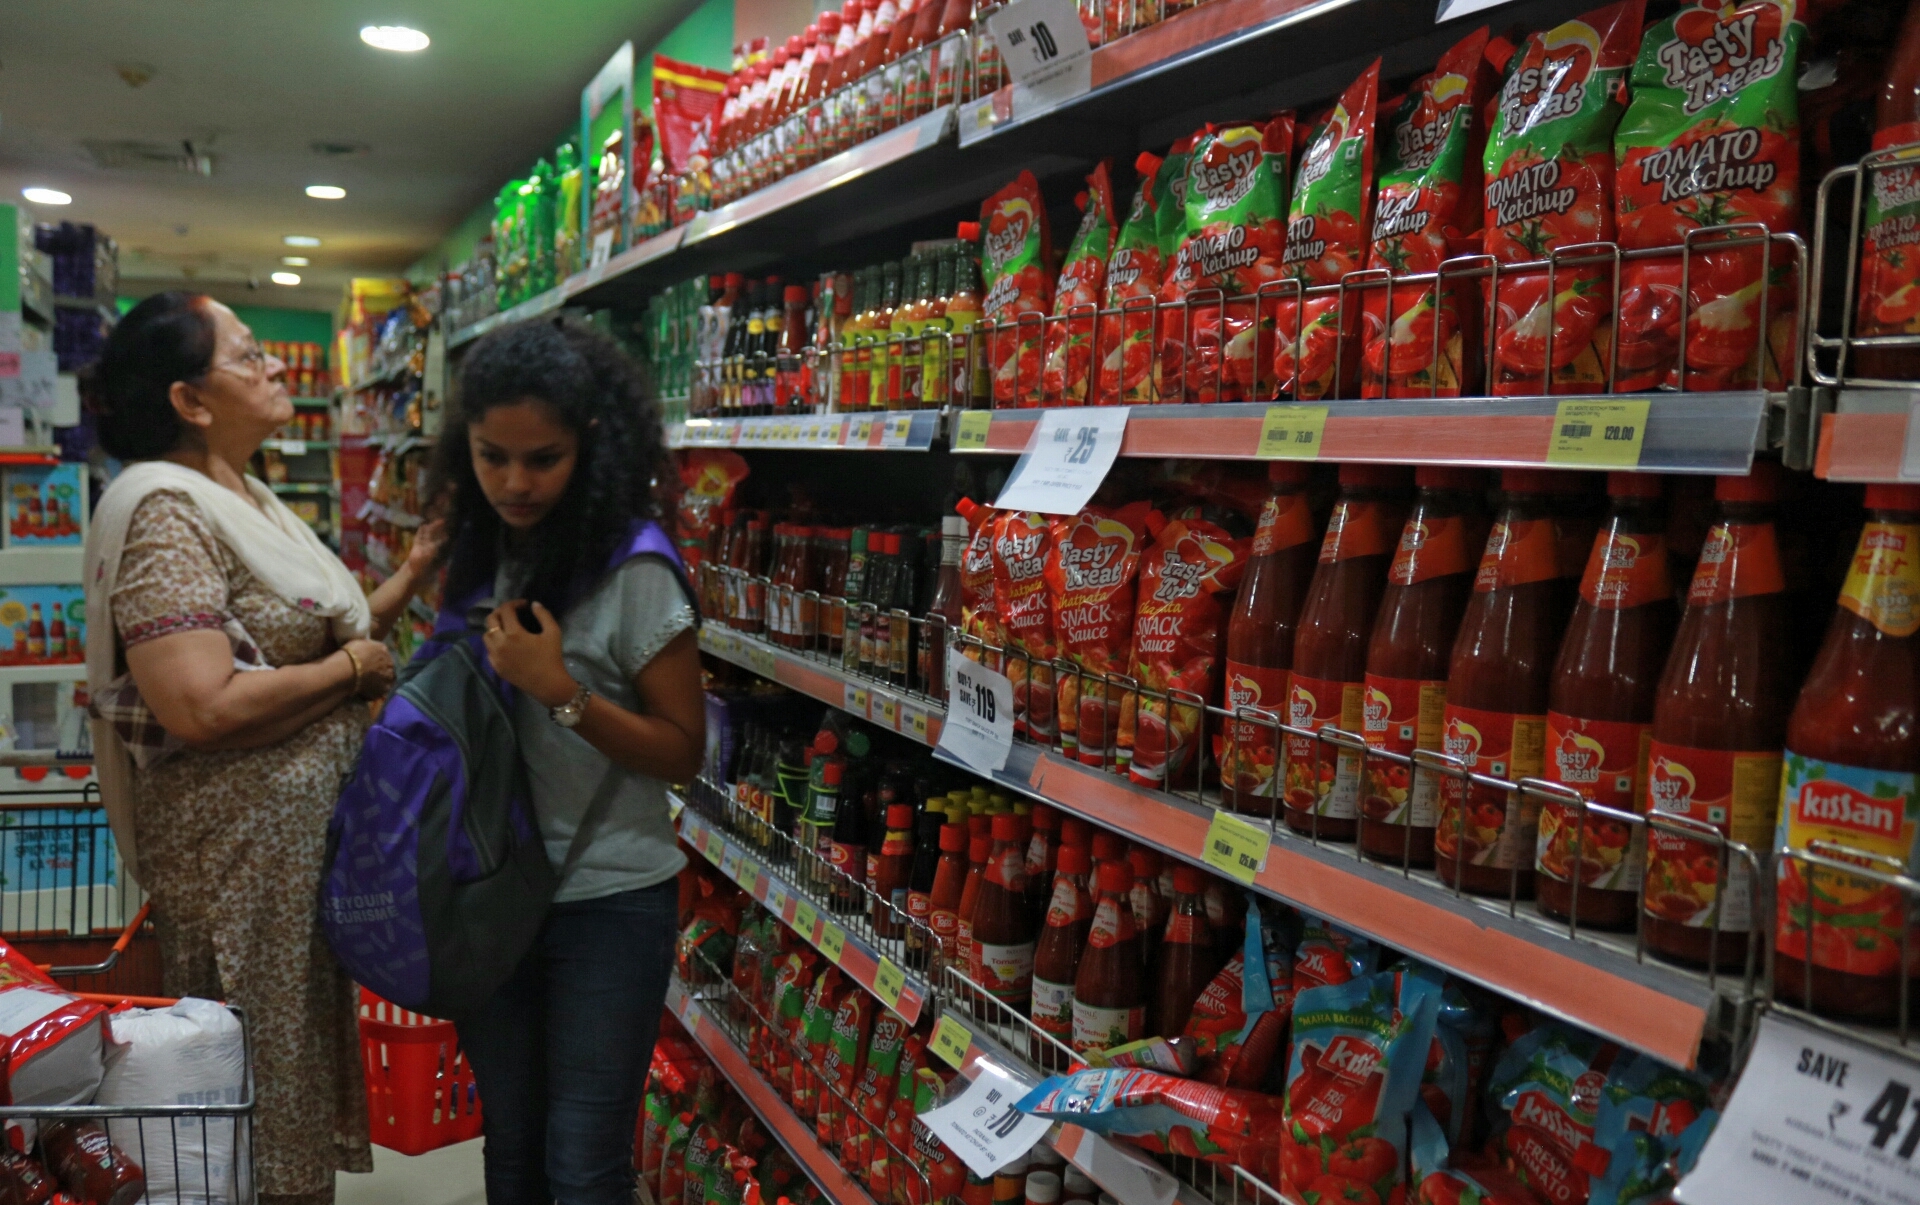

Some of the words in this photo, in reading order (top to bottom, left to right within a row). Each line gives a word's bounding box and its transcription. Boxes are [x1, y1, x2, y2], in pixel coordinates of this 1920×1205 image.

[1662, 14, 1756, 84] Tasty
[1687, 39, 1782, 112] Treat
[1641, 129, 1759, 183] TOMATO
[1193, 150, 1255, 191] Tasty
[1661, 163, 1774, 202] Ketchup
[1487, 160, 1559, 209] TOMATO
[1496, 186, 1576, 226] Ketchup
[1202, 246, 1259, 277] Ketchup
[1604, 426, 1635, 440] 120.00
[996, 533, 1044, 560] Tasty
[1060, 541, 1118, 568] Tasty
[1067, 560, 1121, 588] Treat
[1010, 612, 1045, 630] Sauce
[1061, 603, 1113, 630] SNACK
[1136, 616, 1184, 637] SNACK
[1068, 625, 1109, 645] Sauce
[1139, 634, 1176, 653] Sauce
[1556, 746, 1591, 769] Tasty
[1560, 766, 1600, 782] Treat
[911, 898, 926, 910] Tops
[936, 915, 953, 928] Tops
[1081, 1026, 1108, 1039] Ketchup
[1797, 1047, 1850, 1088] SAVE
[986, 1088, 1003, 1105] BUY
[973, 1106, 987, 1118] @
[913, 1139, 944, 1163] Ketchup
[1524, 1138, 1568, 1181] FRESH
[1515, 1141, 1571, 1201] TOMATO
